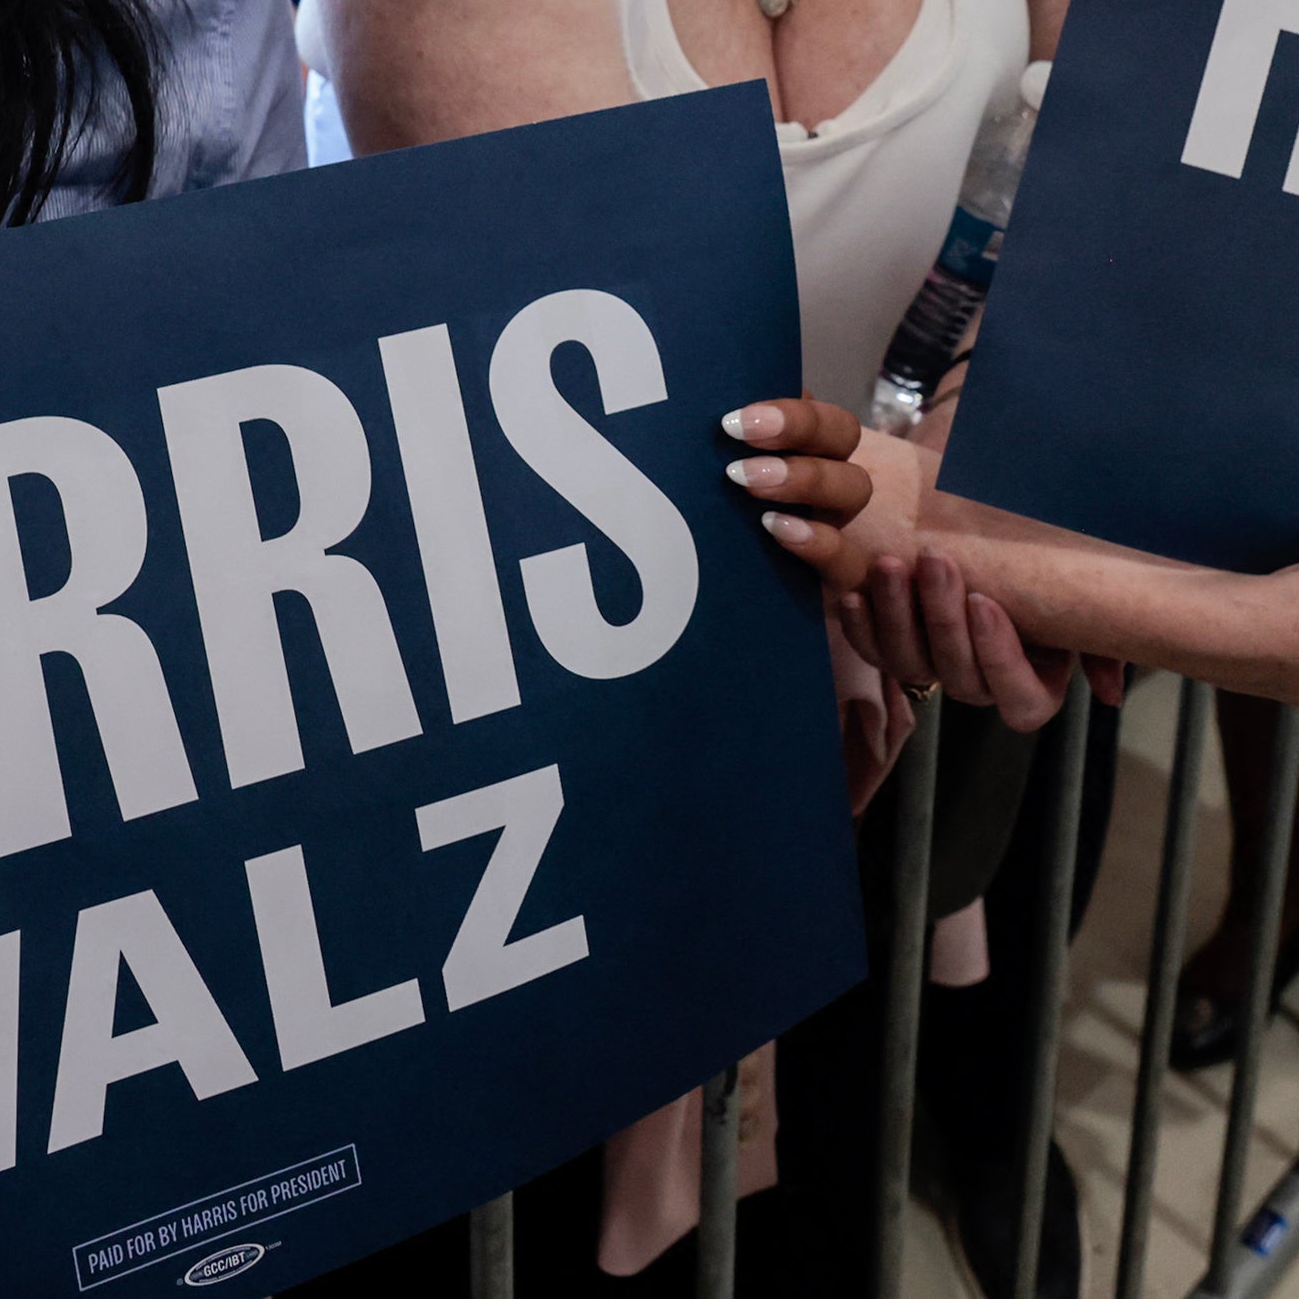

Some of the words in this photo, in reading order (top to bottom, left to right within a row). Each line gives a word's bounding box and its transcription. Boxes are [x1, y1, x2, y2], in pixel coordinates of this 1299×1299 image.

[88, 1244, 124, 1274] PAID
[126, 1232, 156, 1260] FOR
[158, 1221, 178, 1248] BY
[181, 1200, 238, 1238] HARRIS
[240, 1189, 269, 1217] FOR
[271, 1159, 347, 1206] PRESIDENT
